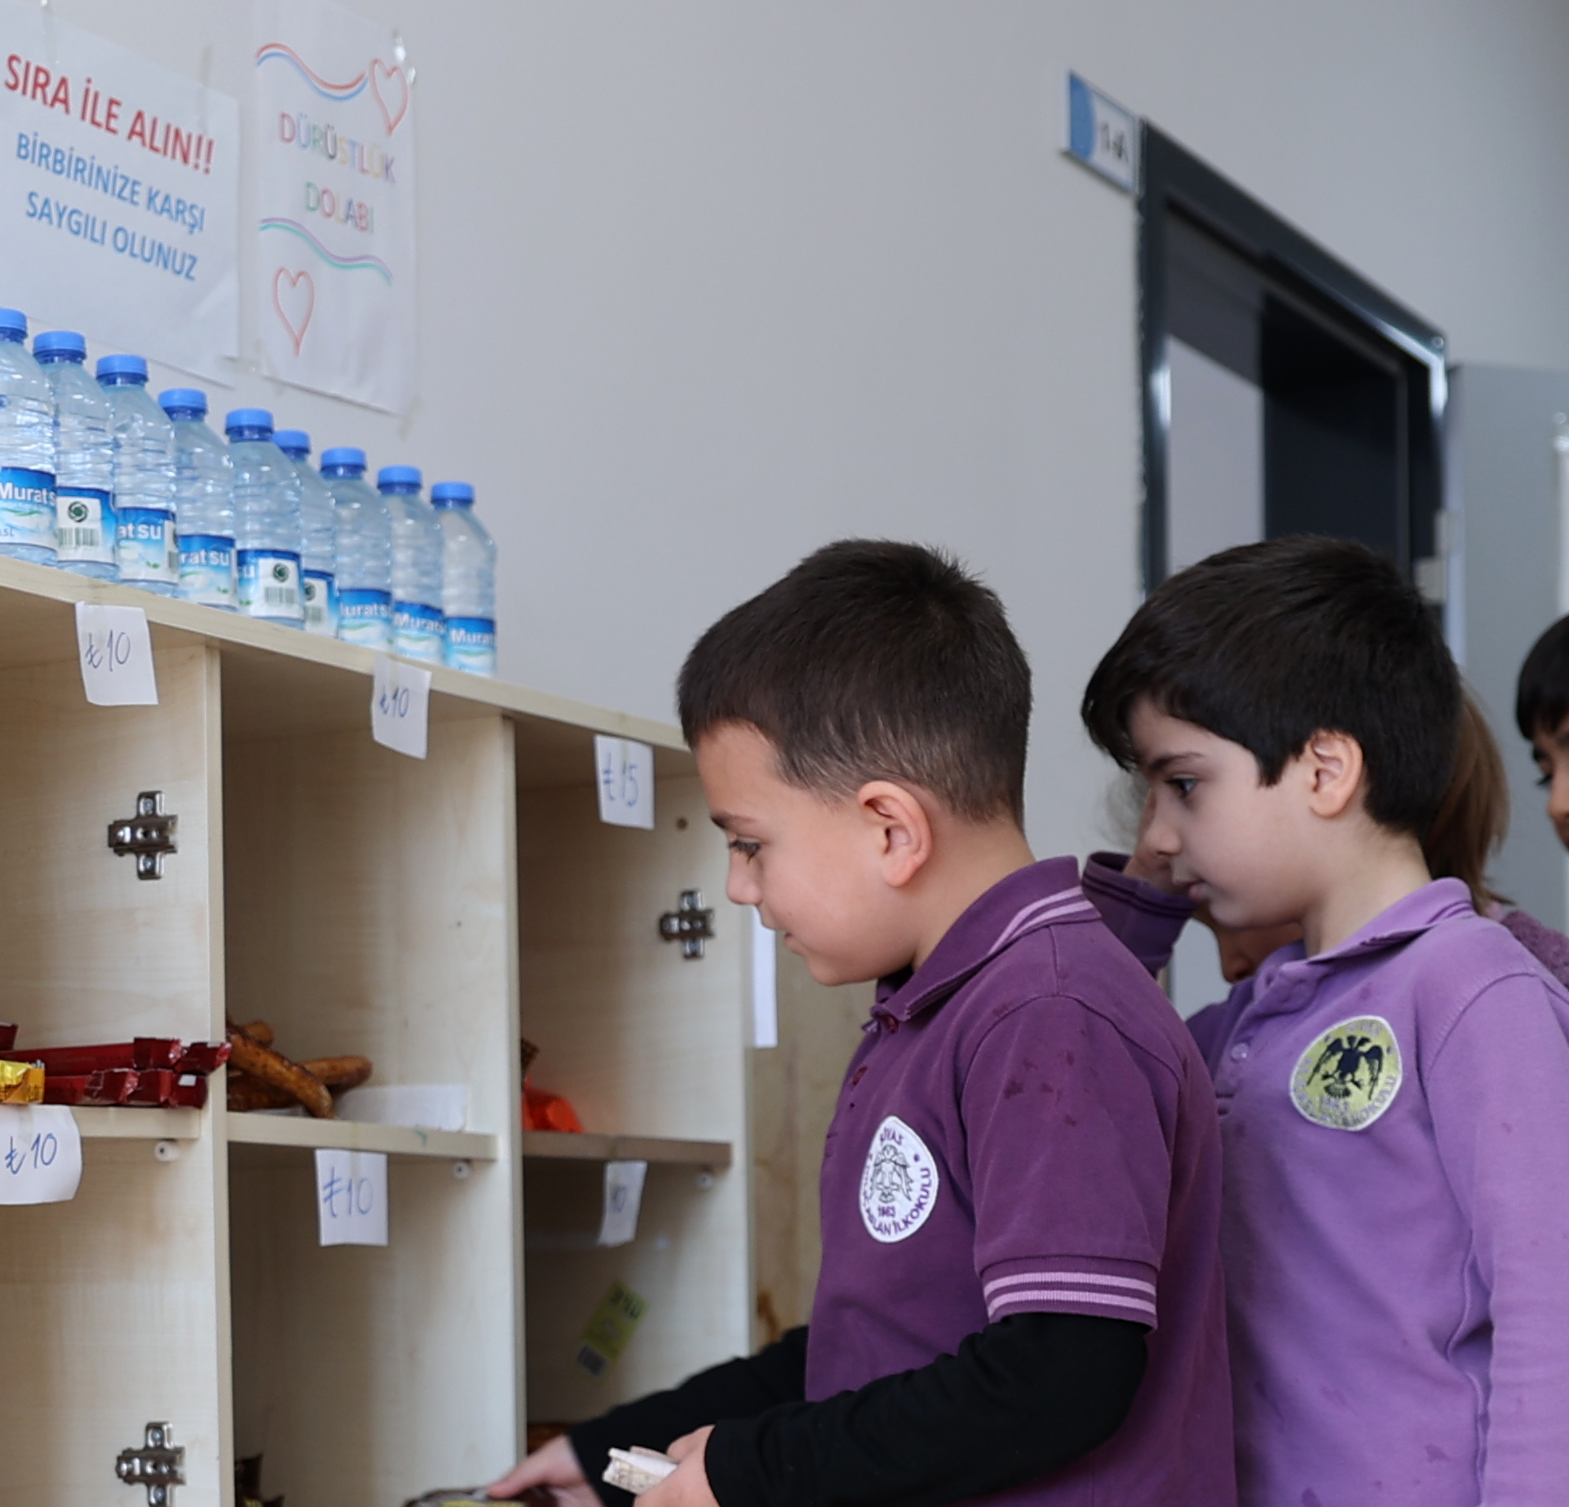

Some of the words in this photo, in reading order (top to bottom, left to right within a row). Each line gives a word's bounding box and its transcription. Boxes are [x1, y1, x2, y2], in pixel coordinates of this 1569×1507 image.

[4, 54, 71, 115] SIRA
[81, 77, 123, 135] İLE
[126, 109, 215, 175] ALIN!!
[280, 111, 396, 184] DÜRÜSTLÜK
[16, 132, 142, 206] BİRBİRİNİZE
[146, 185, 206, 235] KARŞI
[306, 181, 374, 234] DOLABI
[26, 190, 108, 246] SAYGILI
[112, 225, 198, 281] OLUNUZ
